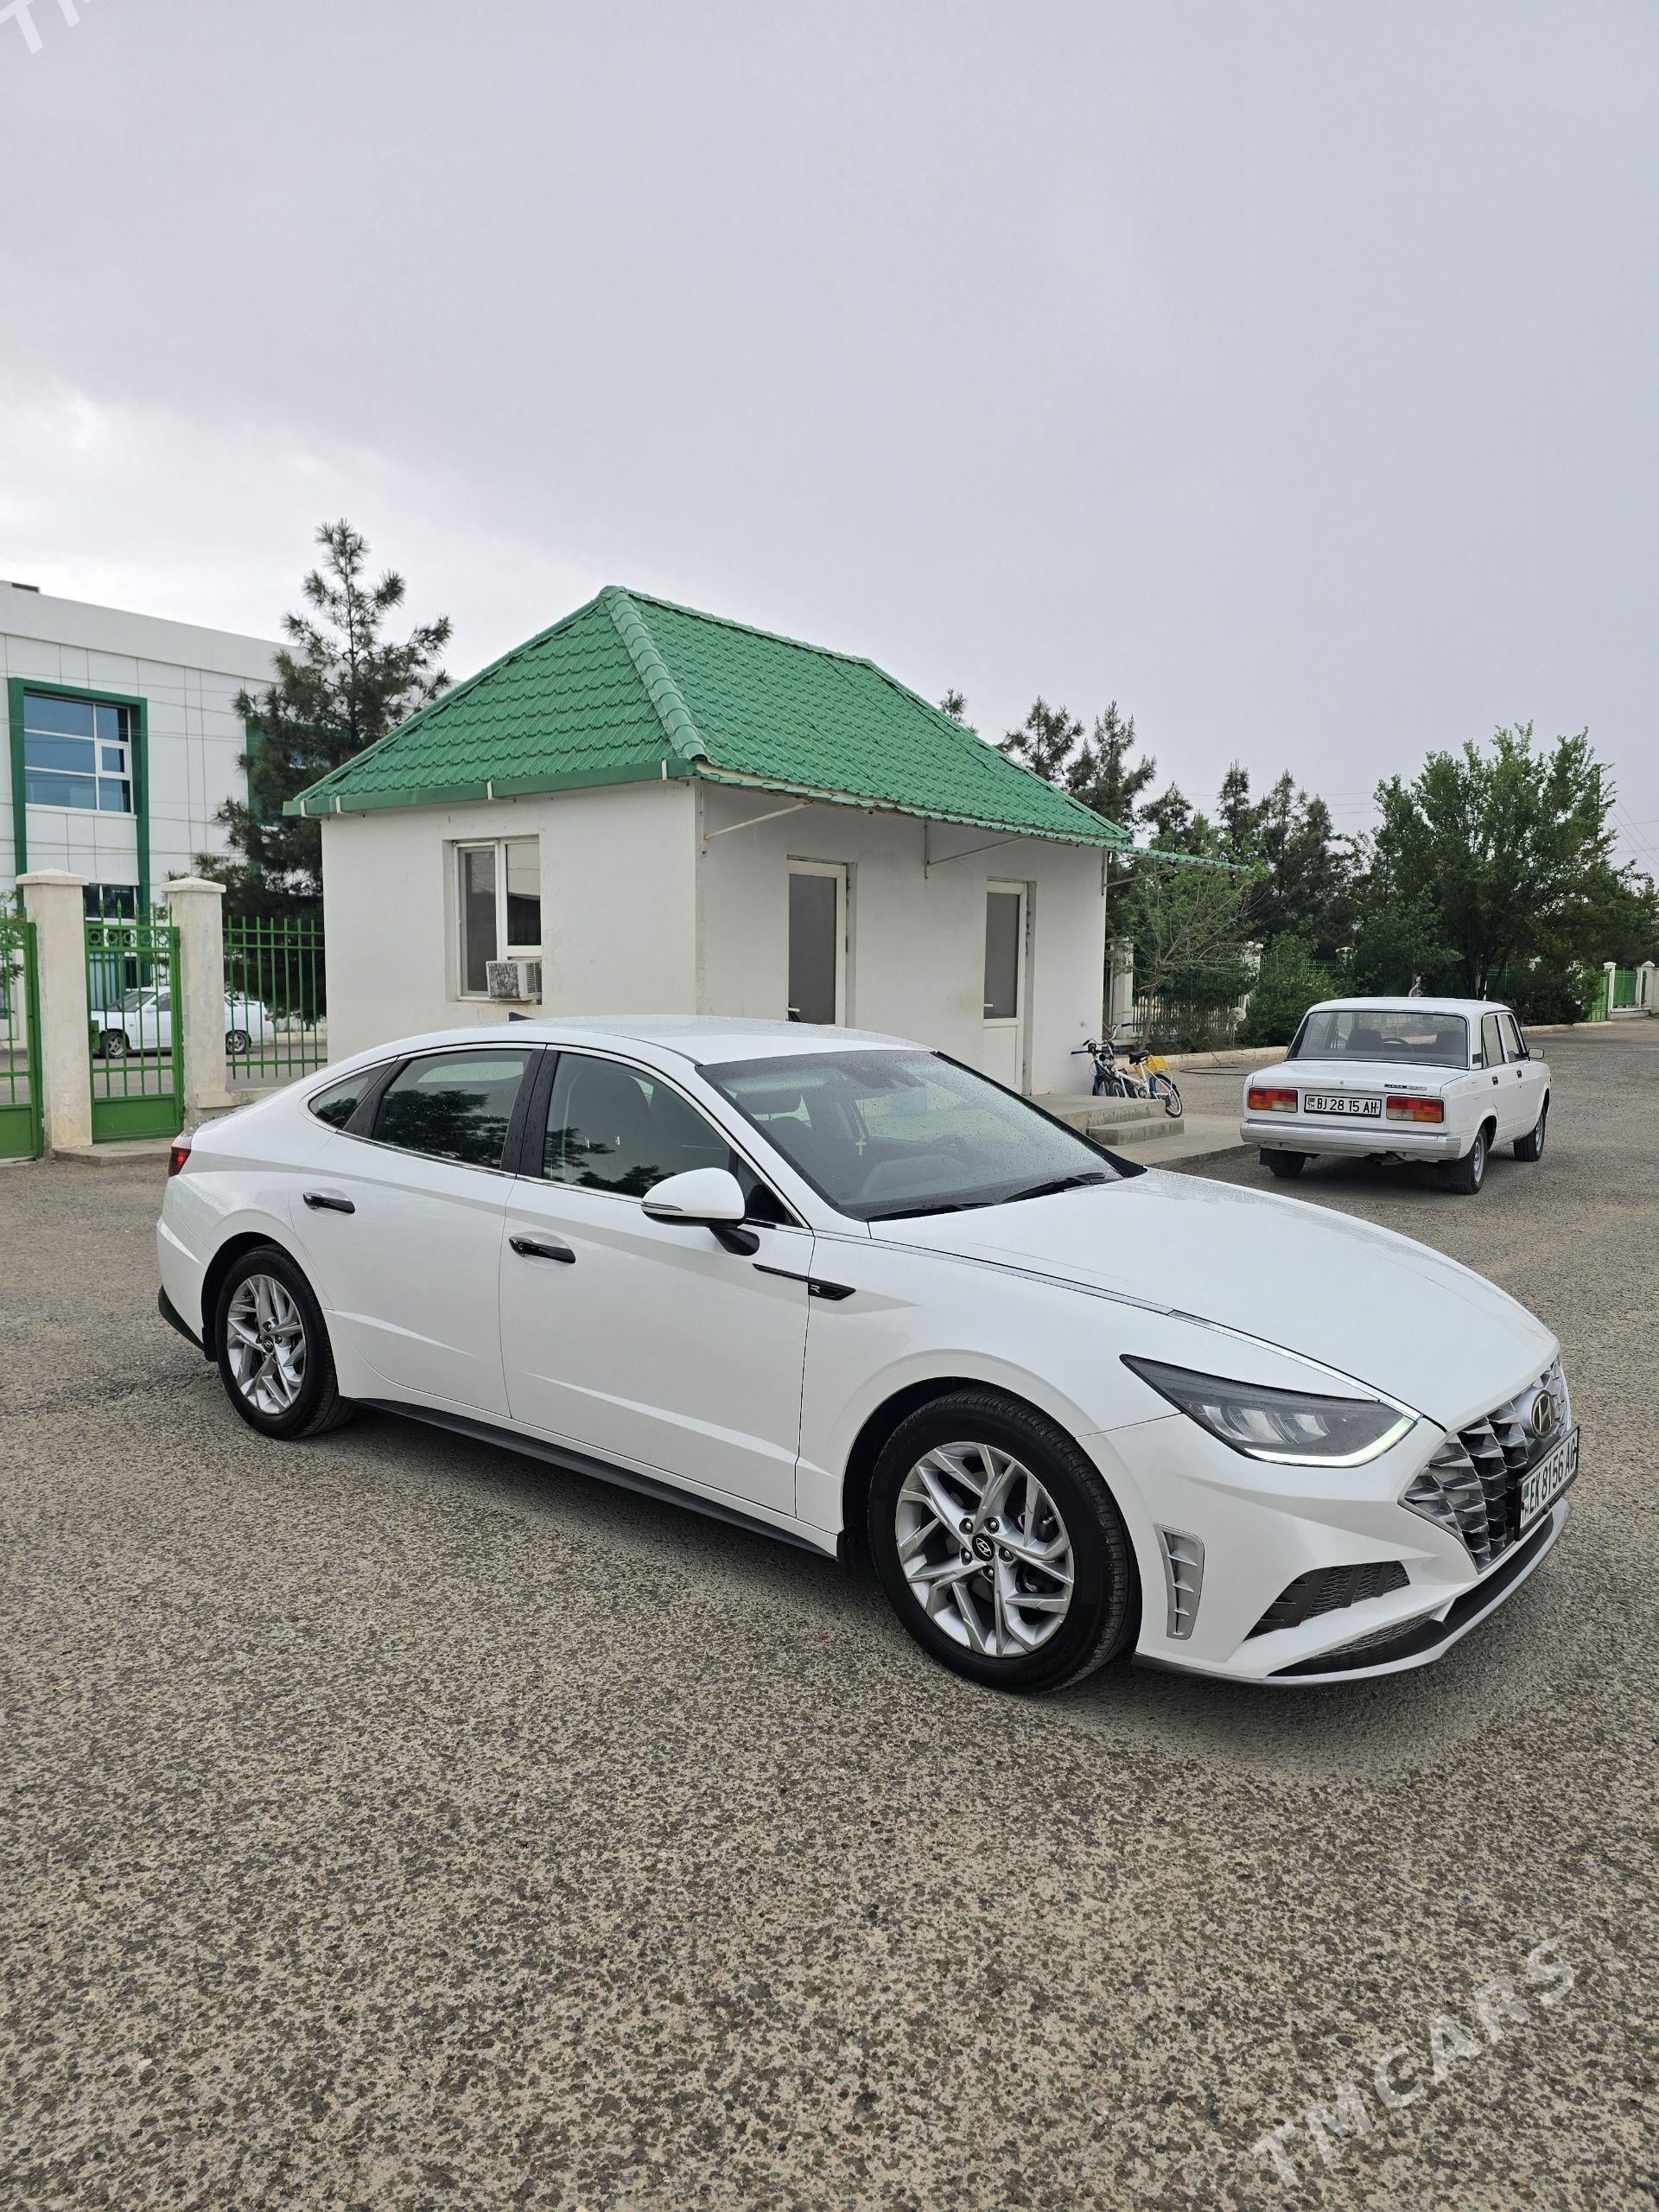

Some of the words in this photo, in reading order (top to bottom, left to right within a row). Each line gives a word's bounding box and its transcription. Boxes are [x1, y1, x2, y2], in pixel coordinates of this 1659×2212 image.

[1317, 1098, 1327, 1109] BJ
[1330, 1099, 1344, 1111] 28
[1348, 1100, 1360, 1112] 15
[1363, 1102, 1377, 1114] AH
[1529, 1472, 1541, 1515] EK
[1541, 1449, 1563, 1500] 8156
